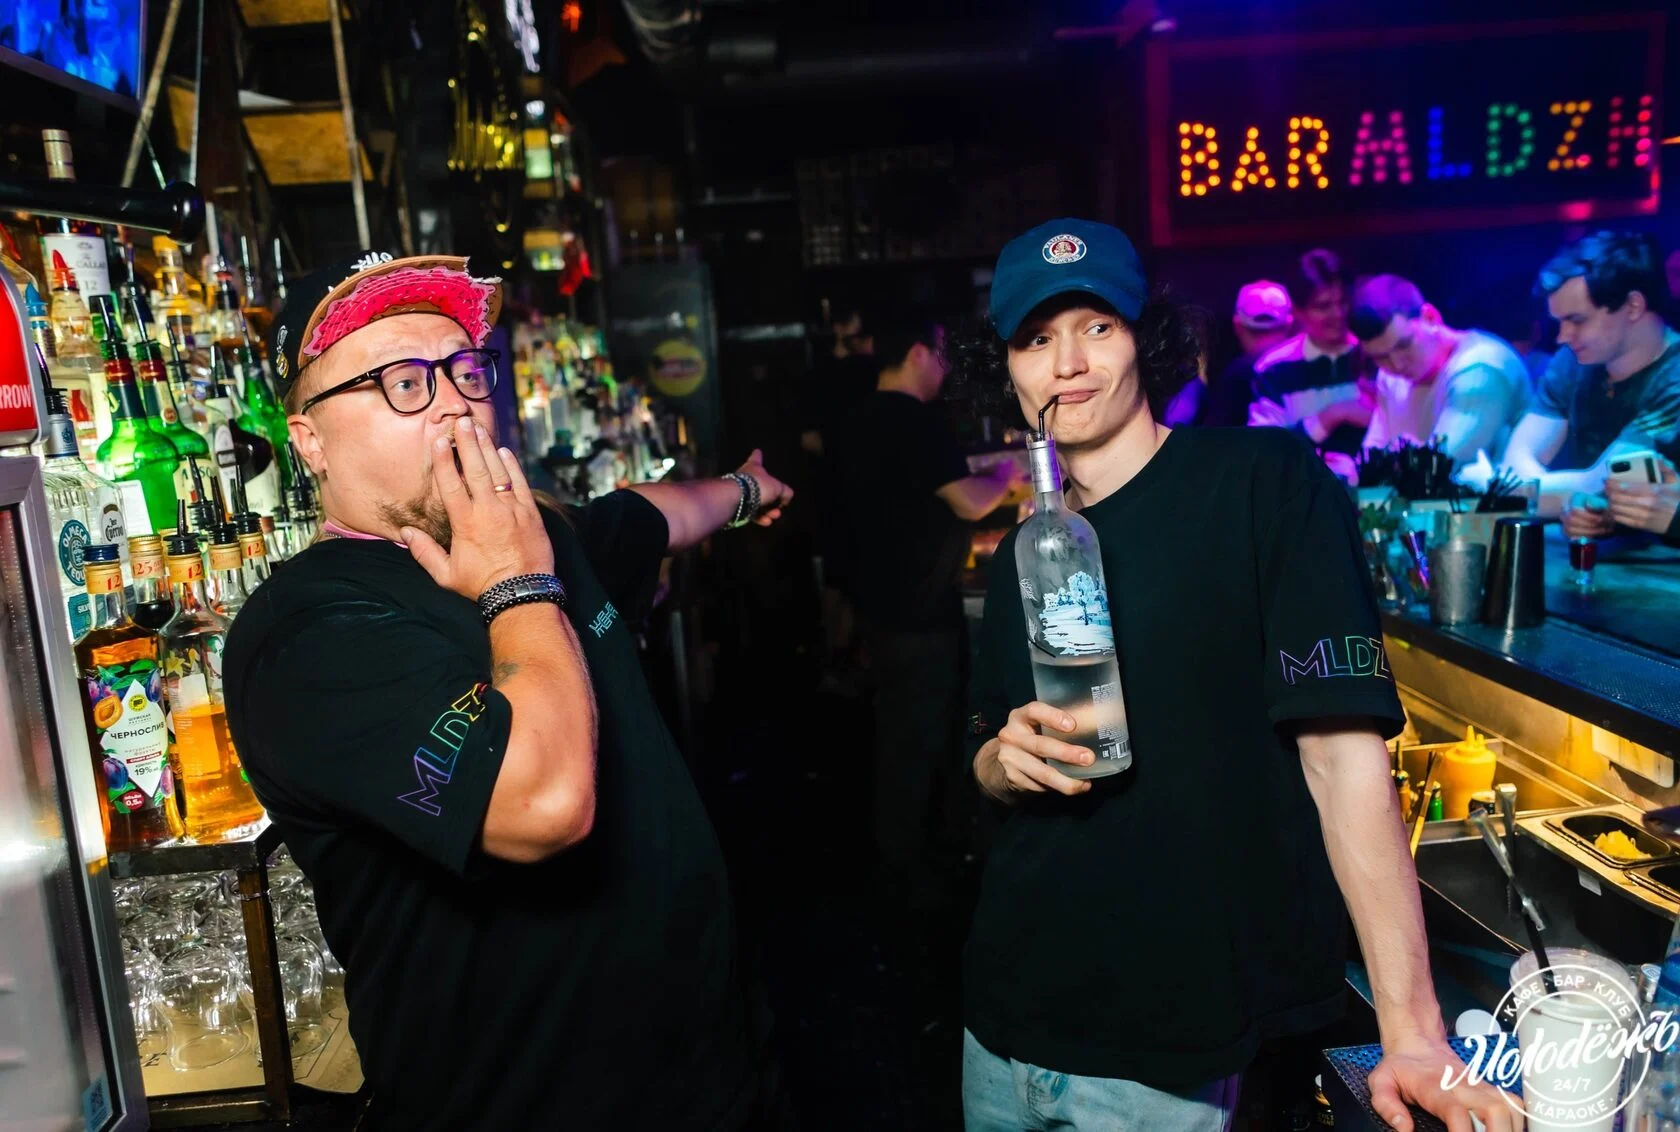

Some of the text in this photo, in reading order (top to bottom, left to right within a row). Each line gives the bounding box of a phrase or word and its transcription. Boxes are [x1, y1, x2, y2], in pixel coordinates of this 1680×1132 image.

[1178, 94, 1653, 197] BAR MLDZH
[110, 721, 165, 740] ЧЕРНОСЛИВ
